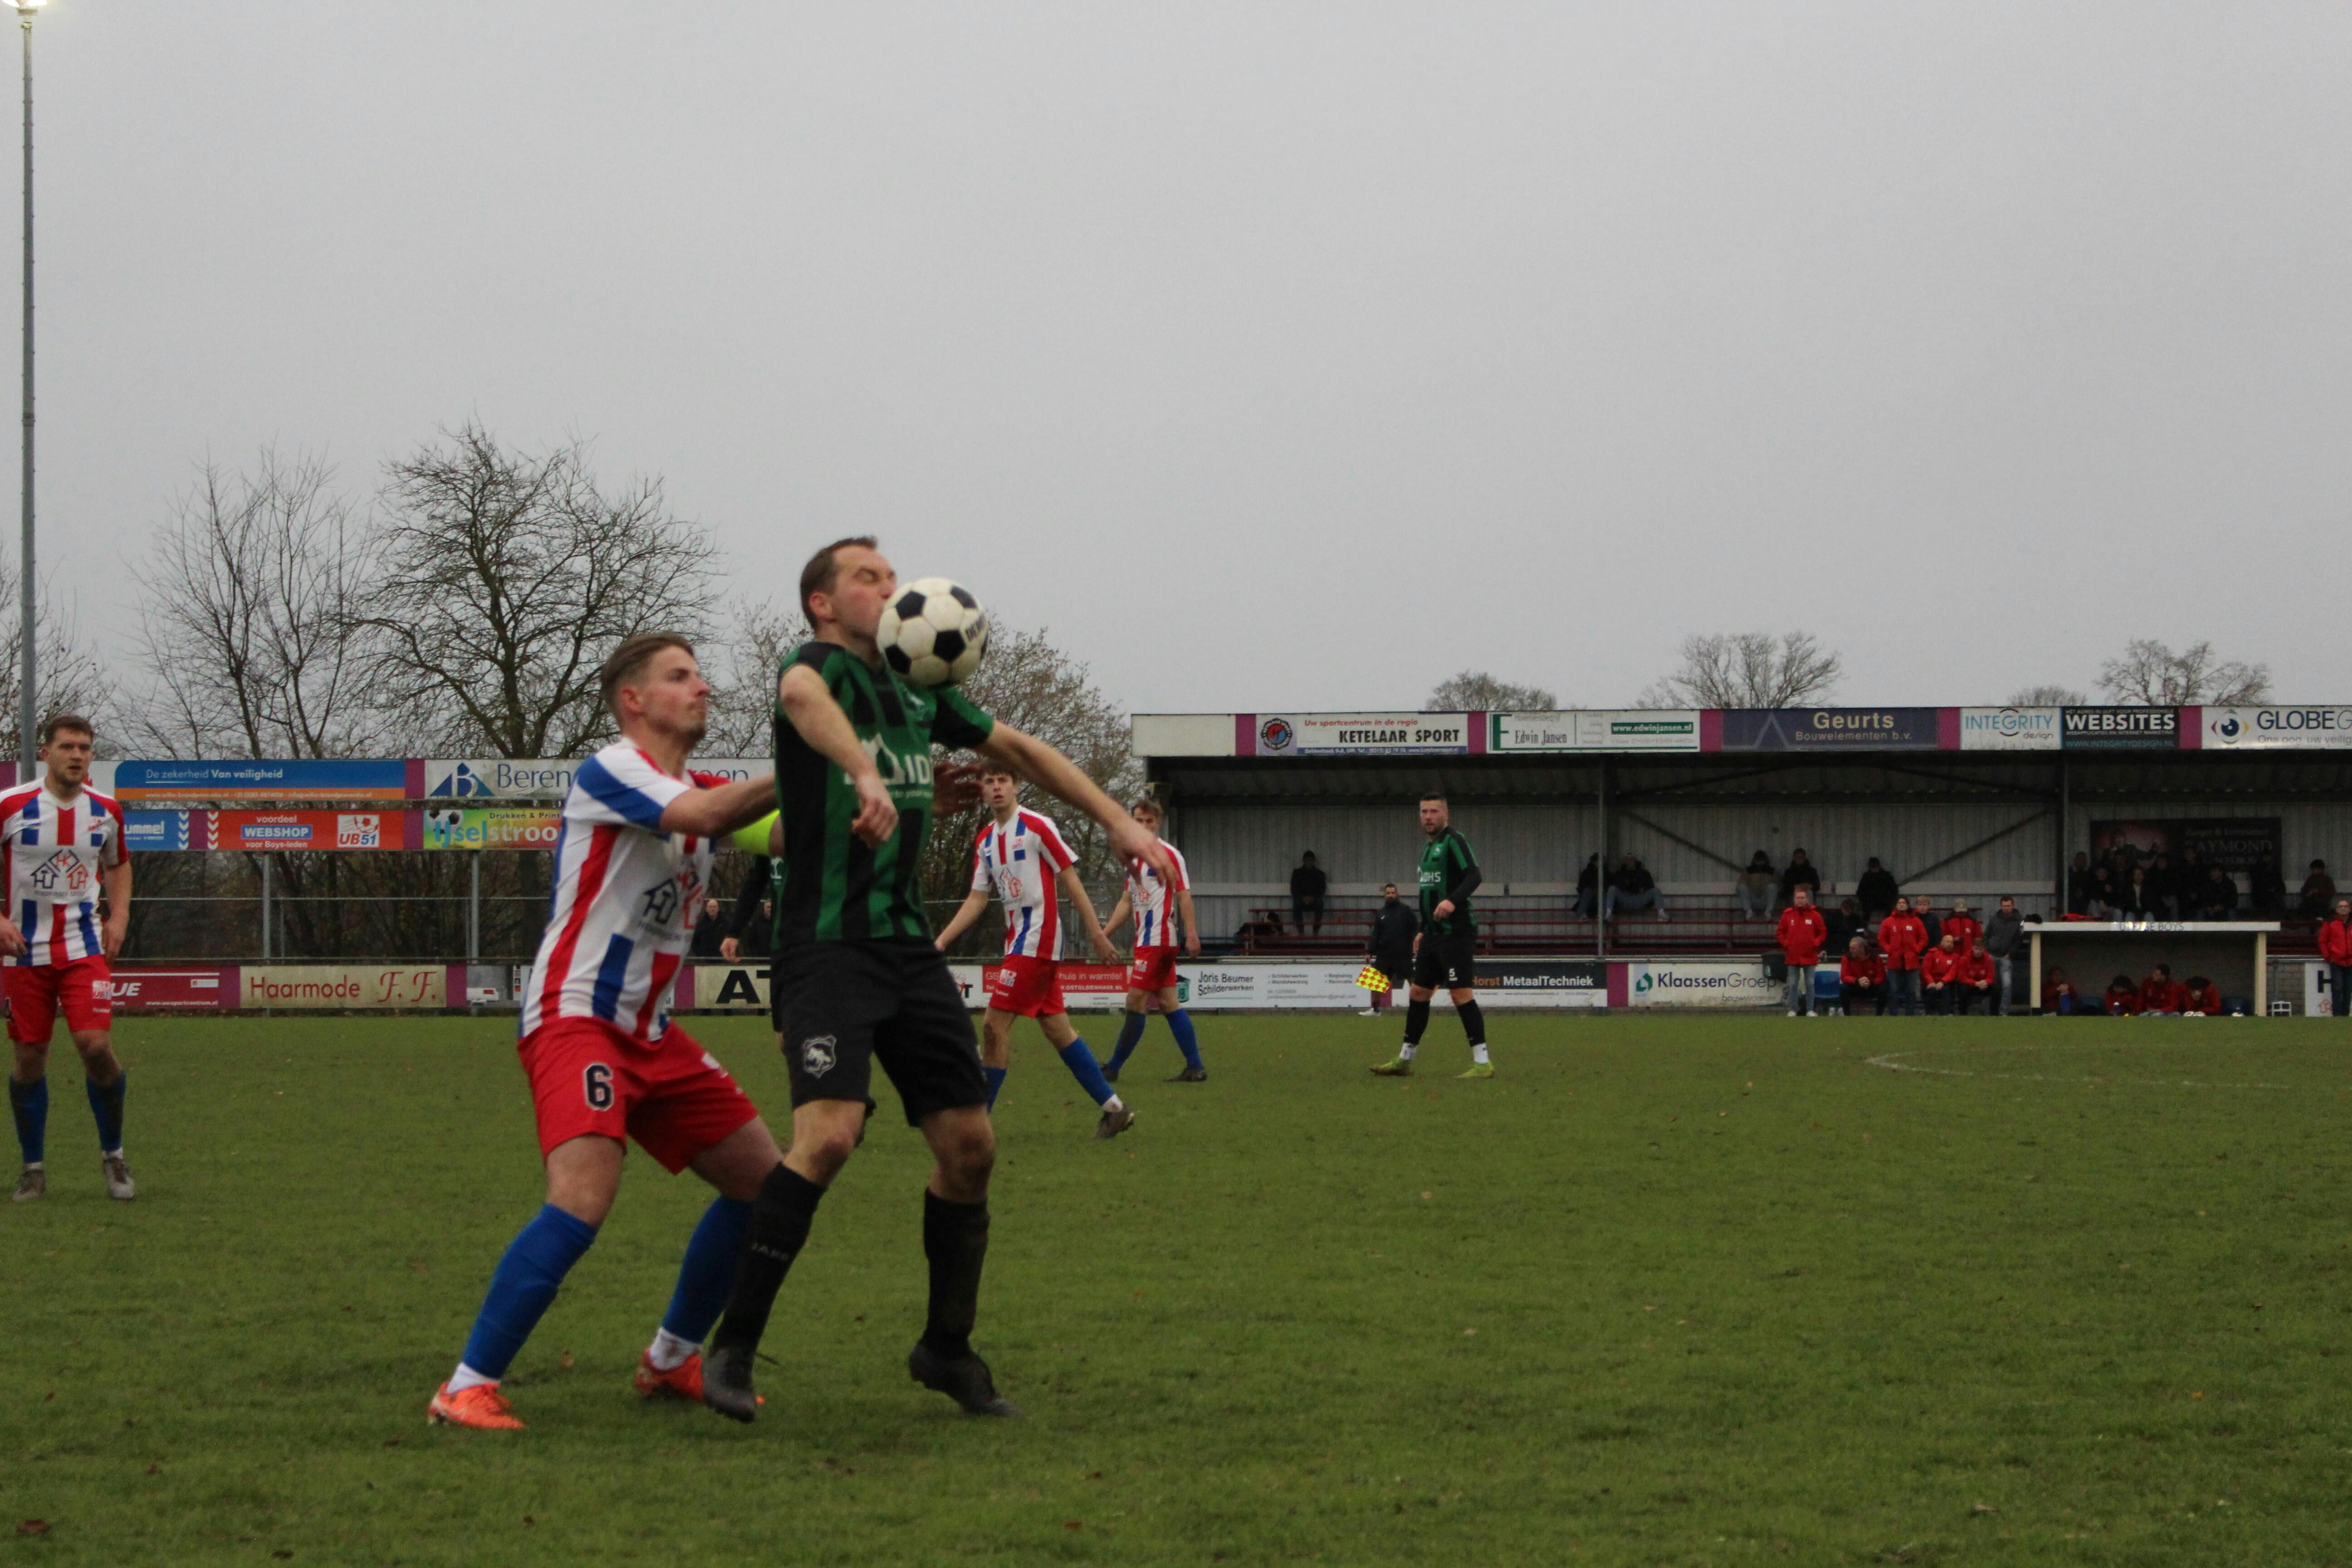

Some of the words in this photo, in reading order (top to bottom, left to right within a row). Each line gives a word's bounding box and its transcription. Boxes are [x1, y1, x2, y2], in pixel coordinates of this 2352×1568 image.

[1320, 719, 1372, 727] sportcentrum
[1813, 711, 1894, 729] Geurts
[1965, 715, 2053, 730] INTEGRITY
[2065, 714, 2175, 730] WEBSITES
[1612, 724, 1692, 733] www.edwinjansen.nl
[1339, 729, 1407, 744] KETELAAR
[1415, 729, 1460, 743] SPORT
[1515, 730, 1539, 744] Edwin
[1542, 730, 1567, 745] Jansen
[1796, 730, 1888, 741] Bouwelementen
[1892, 730, 1912, 740] b.v.
[2024, 731, 2054, 741] design
[2258, 735, 2279, 744] Ons
[146, 769, 160, 779] De
[162, 769, 209, 779] zekerheid
[211, 769, 231, 778] Van
[233, 768, 283, 780] veiligheid
[256, 815, 297, 823] voordeel
[124, 820, 164, 834] ummel
[245, 827, 309, 837] WEBSHOP
[340, 833, 377, 845] UB51
[434, 820, 559, 848] IJselstroo
[265, 841, 308, 849] Boys-leden
[2158, 922, 2184, 931] BOYS
[1198, 971, 1219, 983] Joris
[1221, 974, 1254, 983] Beumer
[1449, 968, 1455, 977] 5
[250, 974, 361, 998] Haarmode
[377, 970, 405, 1003] F.
[411, 970, 438, 1003] F.
[1503, 975, 1594, 987] MetaalTechniek
[1658, 972, 1776, 991] KlaassenGroep
[1198, 984, 1254, 996] Schilderwerken
[583, 1061, 615, 1111] 6
